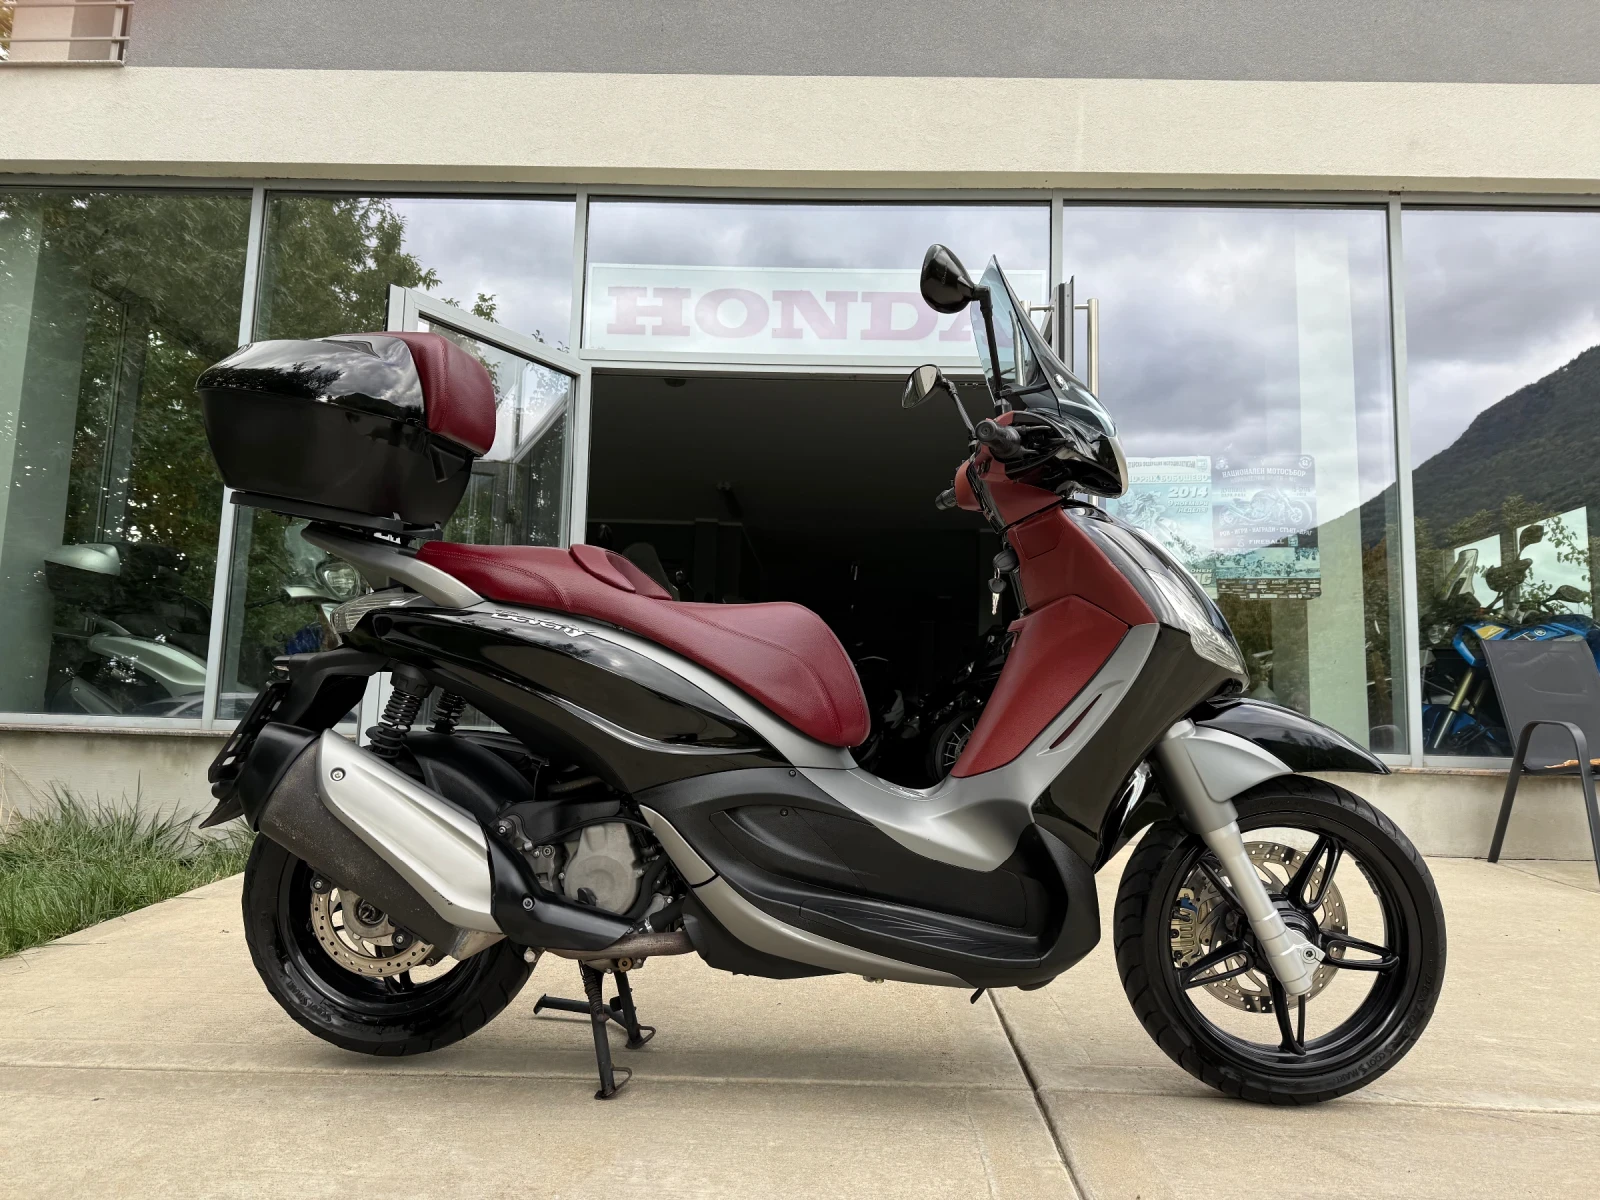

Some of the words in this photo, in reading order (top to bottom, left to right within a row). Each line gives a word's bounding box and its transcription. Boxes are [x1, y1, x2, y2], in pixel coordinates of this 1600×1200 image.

[1222, 468, 1265, 479] НАЦИОНАЛЕН
[1267, 467, 1306, 478] МОТОСЪБОР
[1168, 486, 1209, 499] 2014
